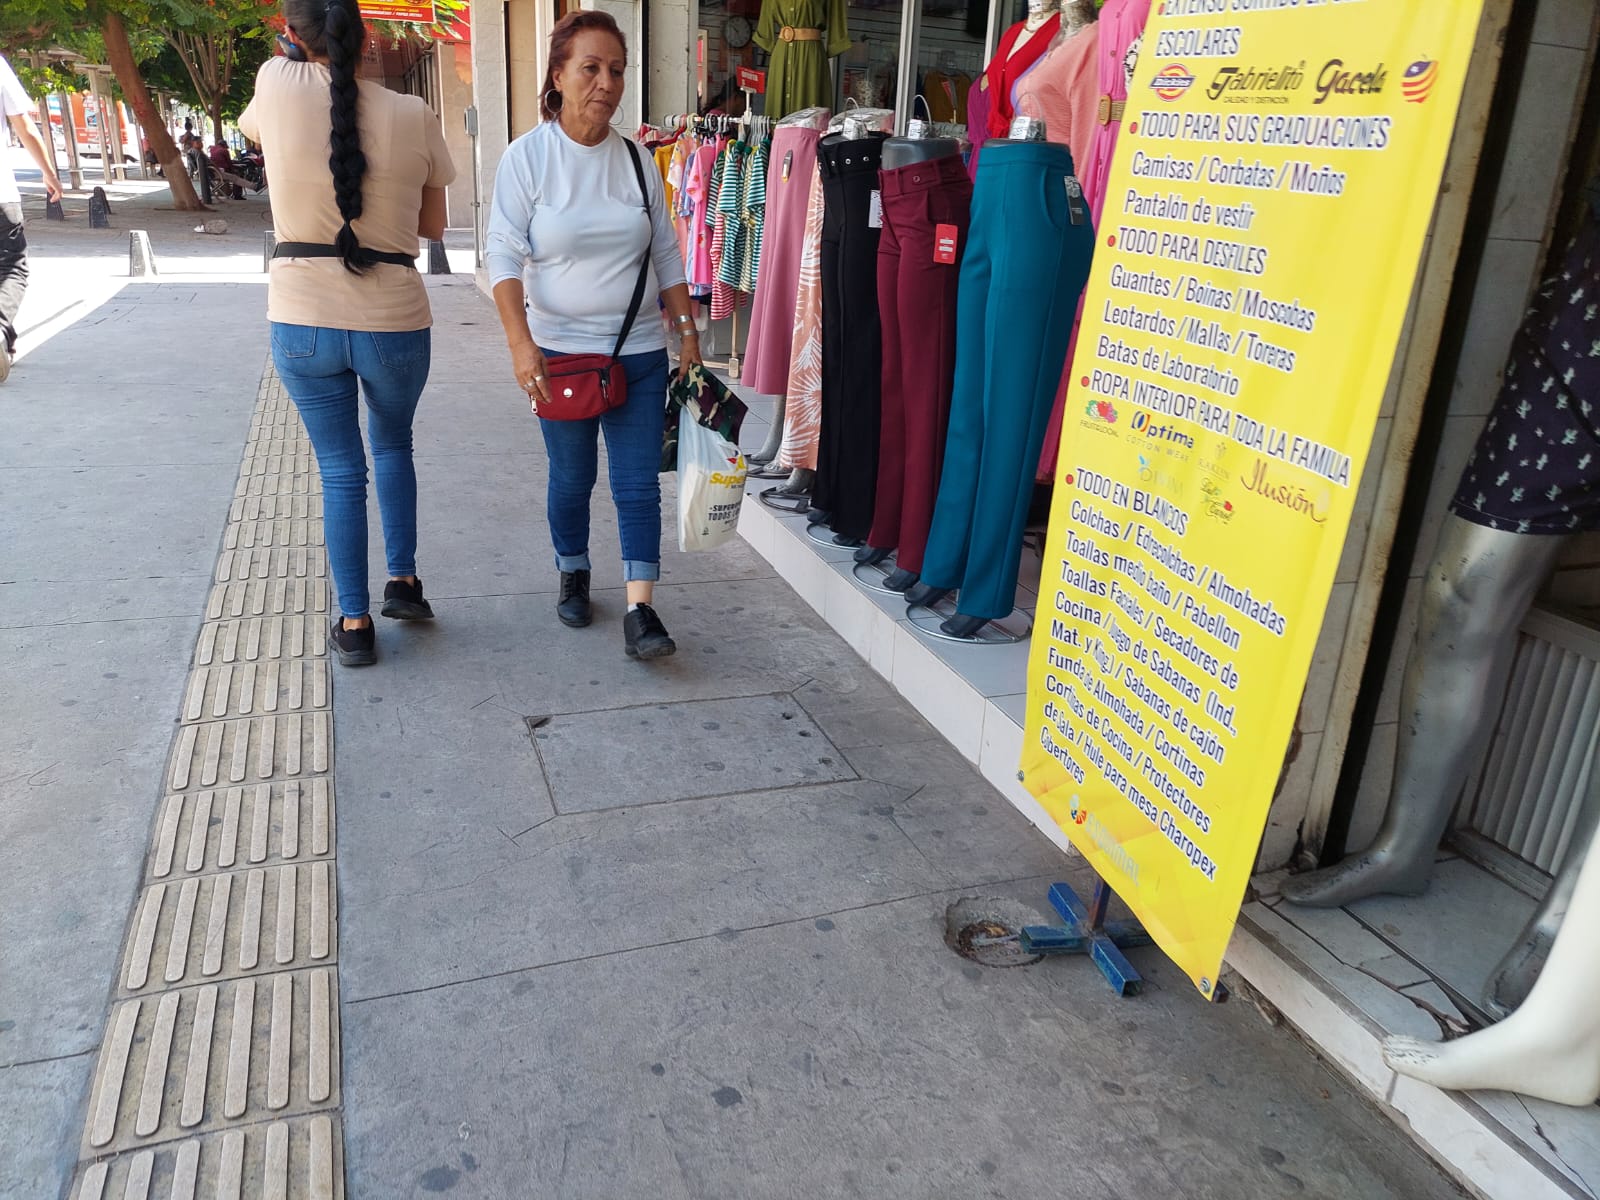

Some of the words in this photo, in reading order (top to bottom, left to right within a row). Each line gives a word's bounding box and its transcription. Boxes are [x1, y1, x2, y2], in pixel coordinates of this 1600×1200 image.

[1156, 29, 1240, 56] ESCOLARES
[1153, 78, 1191, 88] Dickies
[1141, 112, 1179, 137] TODO
[1185, 114, 1219, 139] PARA
[1225, 116, 1259, 141] SUS
[1263, 118, 1389, 147] GRADUACIONES
[1133, 152, 1192, 179] Camisas
[1209, 158, 1274, 187] Corbatas
[1291, 163, 1344, 194] Moños
[1125, 190, 1187, 220] Pantalón
[1193, 198, 1210, 222] de
[1216, 203, 1254, 229] vestir
[1119, 228, 1157, 254] TODO
[1161, 234, 1198, 261] PARA
[1203, 240, 1266, 274] DESFILES
[1112, 265, 1170, 296] Guantes
[1186, 278, 1232, 309] Boinas
[1098, 336, 1139, 364] Batas
[1143, 347, 1159, 370] de
[1162, 351, 1238, 395] Laboratorio
[1104, 301, 1175, 336] Leotardos
[1187, 318, 1231, 351] Mallas
[1248, 333, 1294, 371] Toreras
[1092, 370, 1128, 397] ROPA
[1133, 381, 1197, 419] INTERIOR
[1200, 402, 1229, 434] PARA
[1233, 415, 1262, 450] TODA
[1268, 430, 1286, 459] LA
[1290, 435, 1350, 486] FAMILIA
[1131, 411, 1194, 448] Optima
[1077, 468, 1111, 498] TODO
[1113, 483, 1129, 508] EN
[1134, 490, 1187, 536] BLANCOS
[1067, 530, 1109, 566] Toallas
[1114, 556, 1145, 586] medio
[1147, 571, 1170, 605] baño
[1183, 596, 1239, 650] Pabellon
[1071, 501, 1119, 537] Colchas
[1207, 572, 1285, 635] Almohadas
[1062, 560, 1105, 595] Toallas
[1154, 617, 1218, 676] Secadores
[1221, 665, 1238, 689] de
[1052, 620, 1081, 646] Mat.
[1085, 637, 1093, 652] y
[1125, 668, 1170, 720] Sabanas
[1173, 709, 1187, 732] de
[1190, 724, 1224, 763] cajón
[1056, 592, 1100, 624] Cocina
[1133, 642, 1147, 663] de
[1151, 651, 1200, 703] Sabanas
[1206, 691, 1236, 737] (Ind.,
[1048, 648, 1085, 680] Funda
[1084, 672, 1093, 691] de
[1093, 676, 1144, 733] Almohada
[1155, 731, 1205, 787] Cortinas
[1047, 675, 1084, 718] Cortinas
[1087, 709, 1099, 729] de
[1102, 719, 1133, 767] Cocina
[1143, 758, 1210, 832] Protectores
[1044, 702, 1058, 721] de
[1084, 735, 1103, 768] Hule
[1104, 762, 1128, 793] para
[1129, 785, 1156, 824] mesa
[1159, 811, 1216, 880] Charopex
